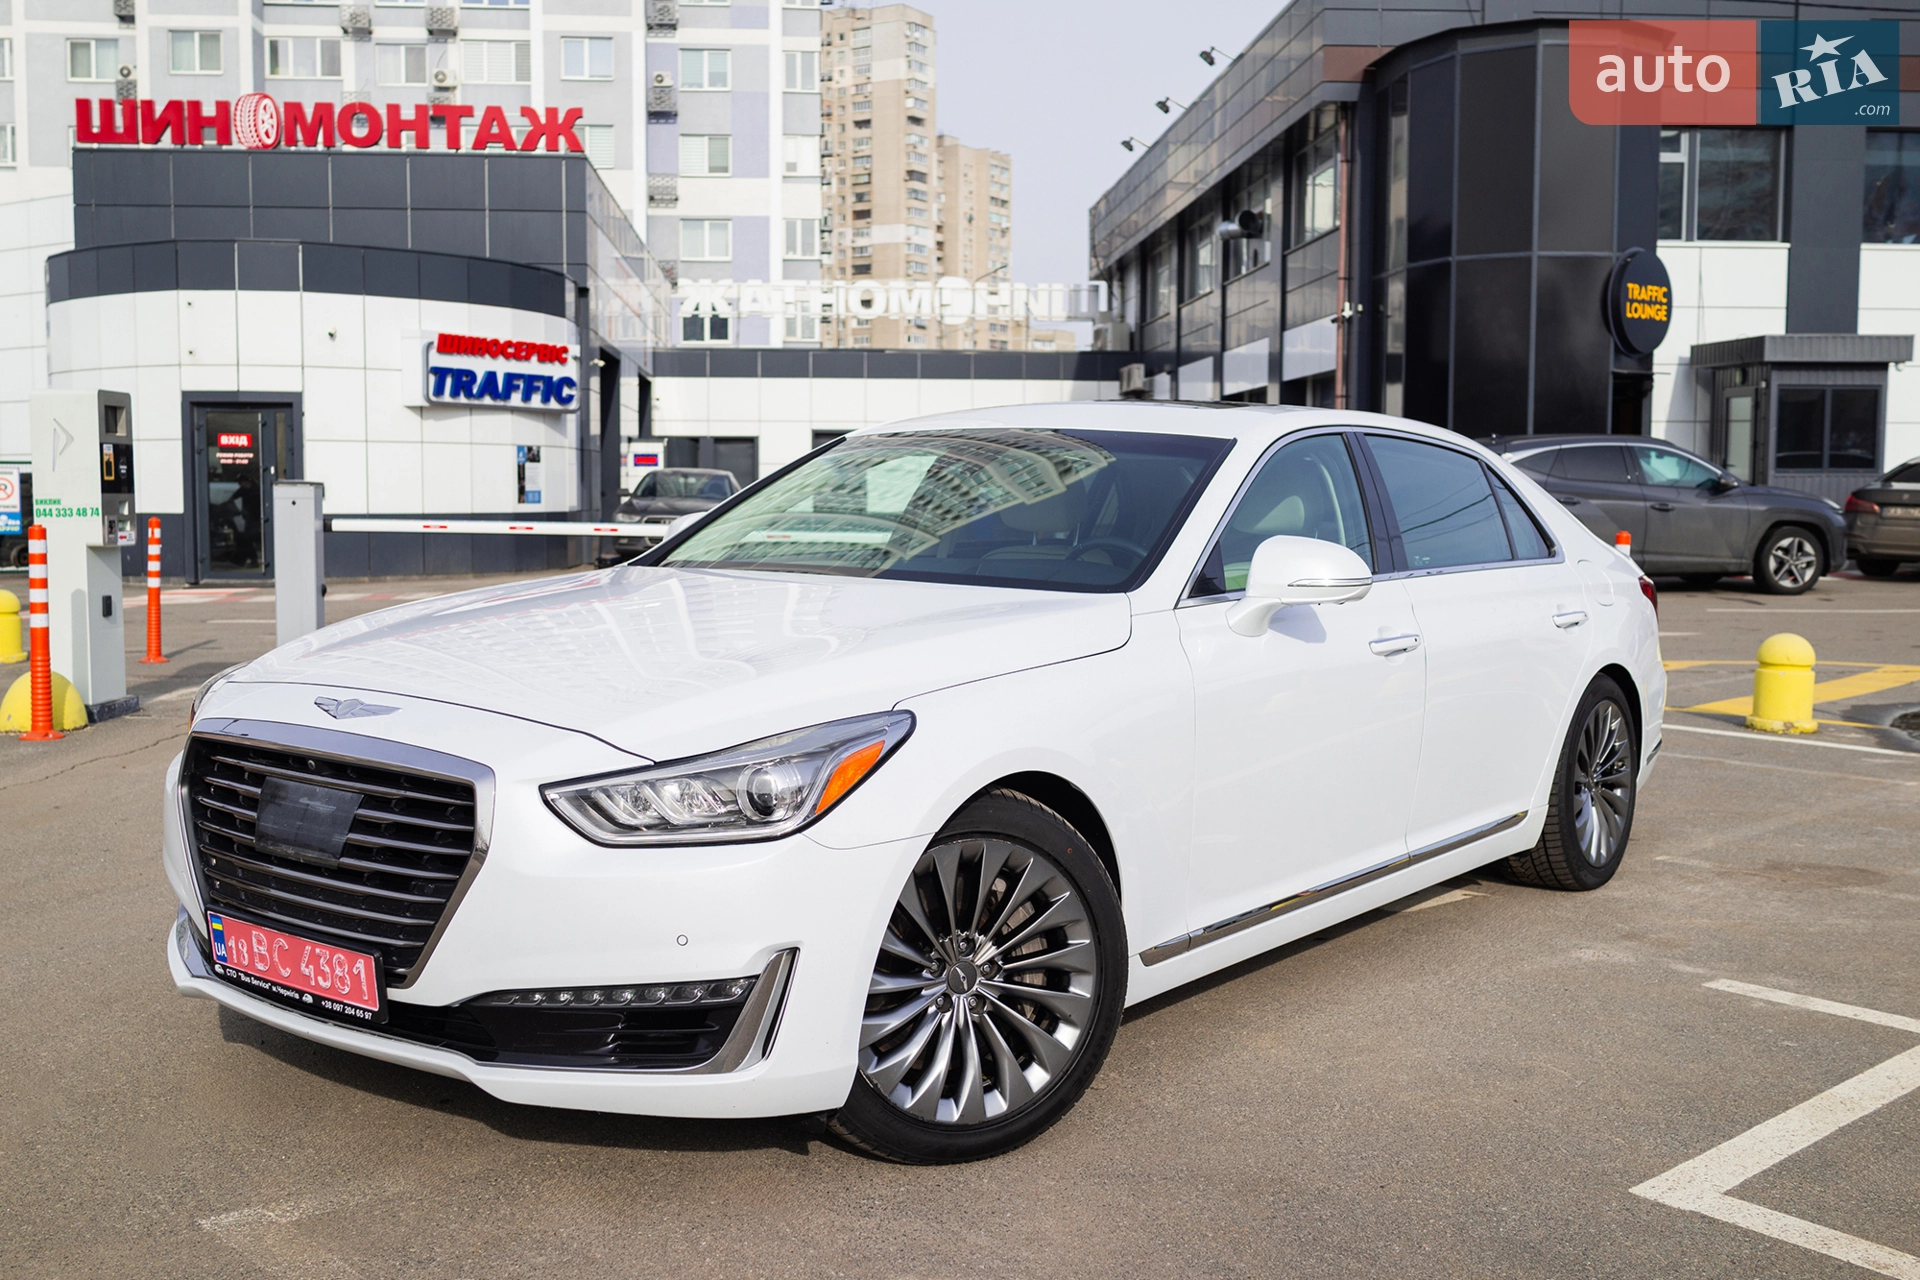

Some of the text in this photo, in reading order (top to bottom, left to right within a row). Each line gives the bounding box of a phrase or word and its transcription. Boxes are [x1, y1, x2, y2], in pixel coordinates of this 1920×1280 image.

[1626, 283, 1668, 303] TRAFFIC
[1625, 301, 1668, 322] LOUNGE
[437, 333, 569, 365] ШИНОСЕРВІС
[430, 366, 577, 404] TRAFFIC
[220, 435, 248, 447] ВХІД
[35, 507, 100, 518] 044 333 48 74
[214, 941, 228, 958] UA
[228, 936, 248, 967] 18
[300, 945, 368, 1000] 4381
[321, 999, 373, 1020] +38 097 204 65 97
